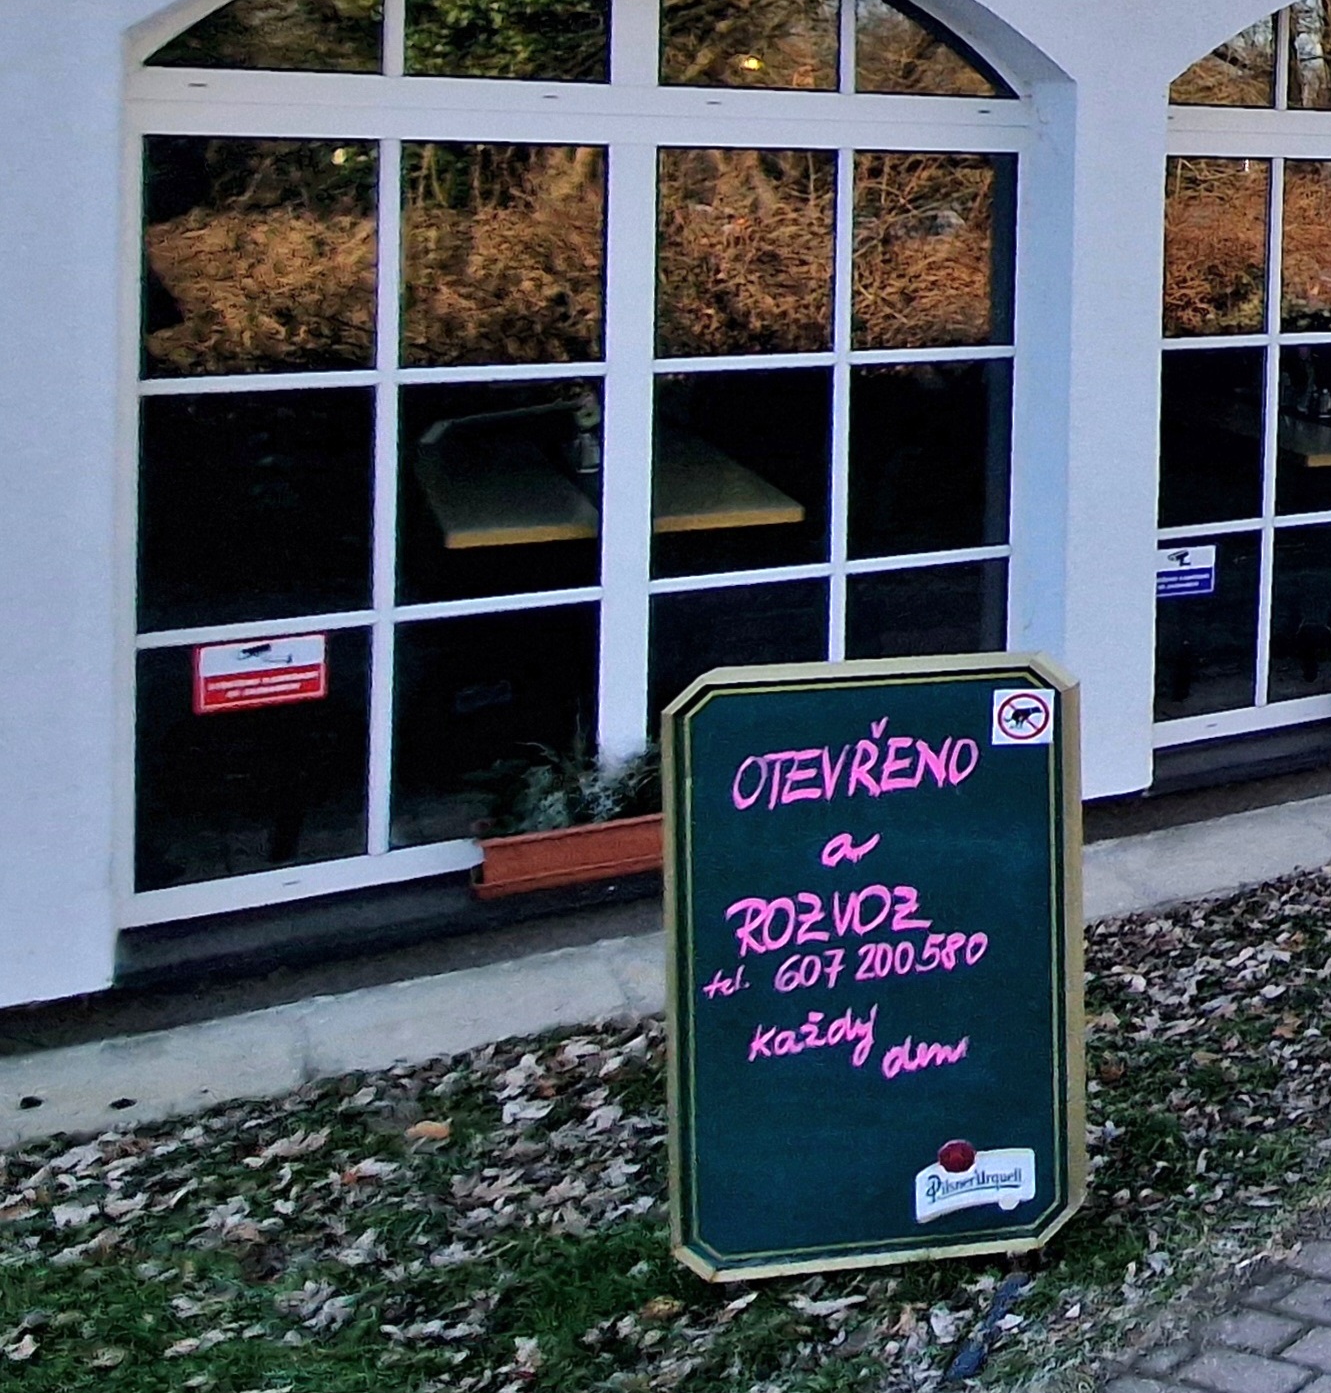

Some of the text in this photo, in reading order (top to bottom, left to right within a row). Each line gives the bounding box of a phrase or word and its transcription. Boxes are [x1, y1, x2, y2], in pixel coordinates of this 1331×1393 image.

[732, 716, 979, 810] OTEVŘENO
[821, 833, 881, 867] a
[725, 884, 933, 957] ROZVOZ
[774, 948, 846, 992] 607
[926, 1168, 1022, 1204] Pilsner Urquell
